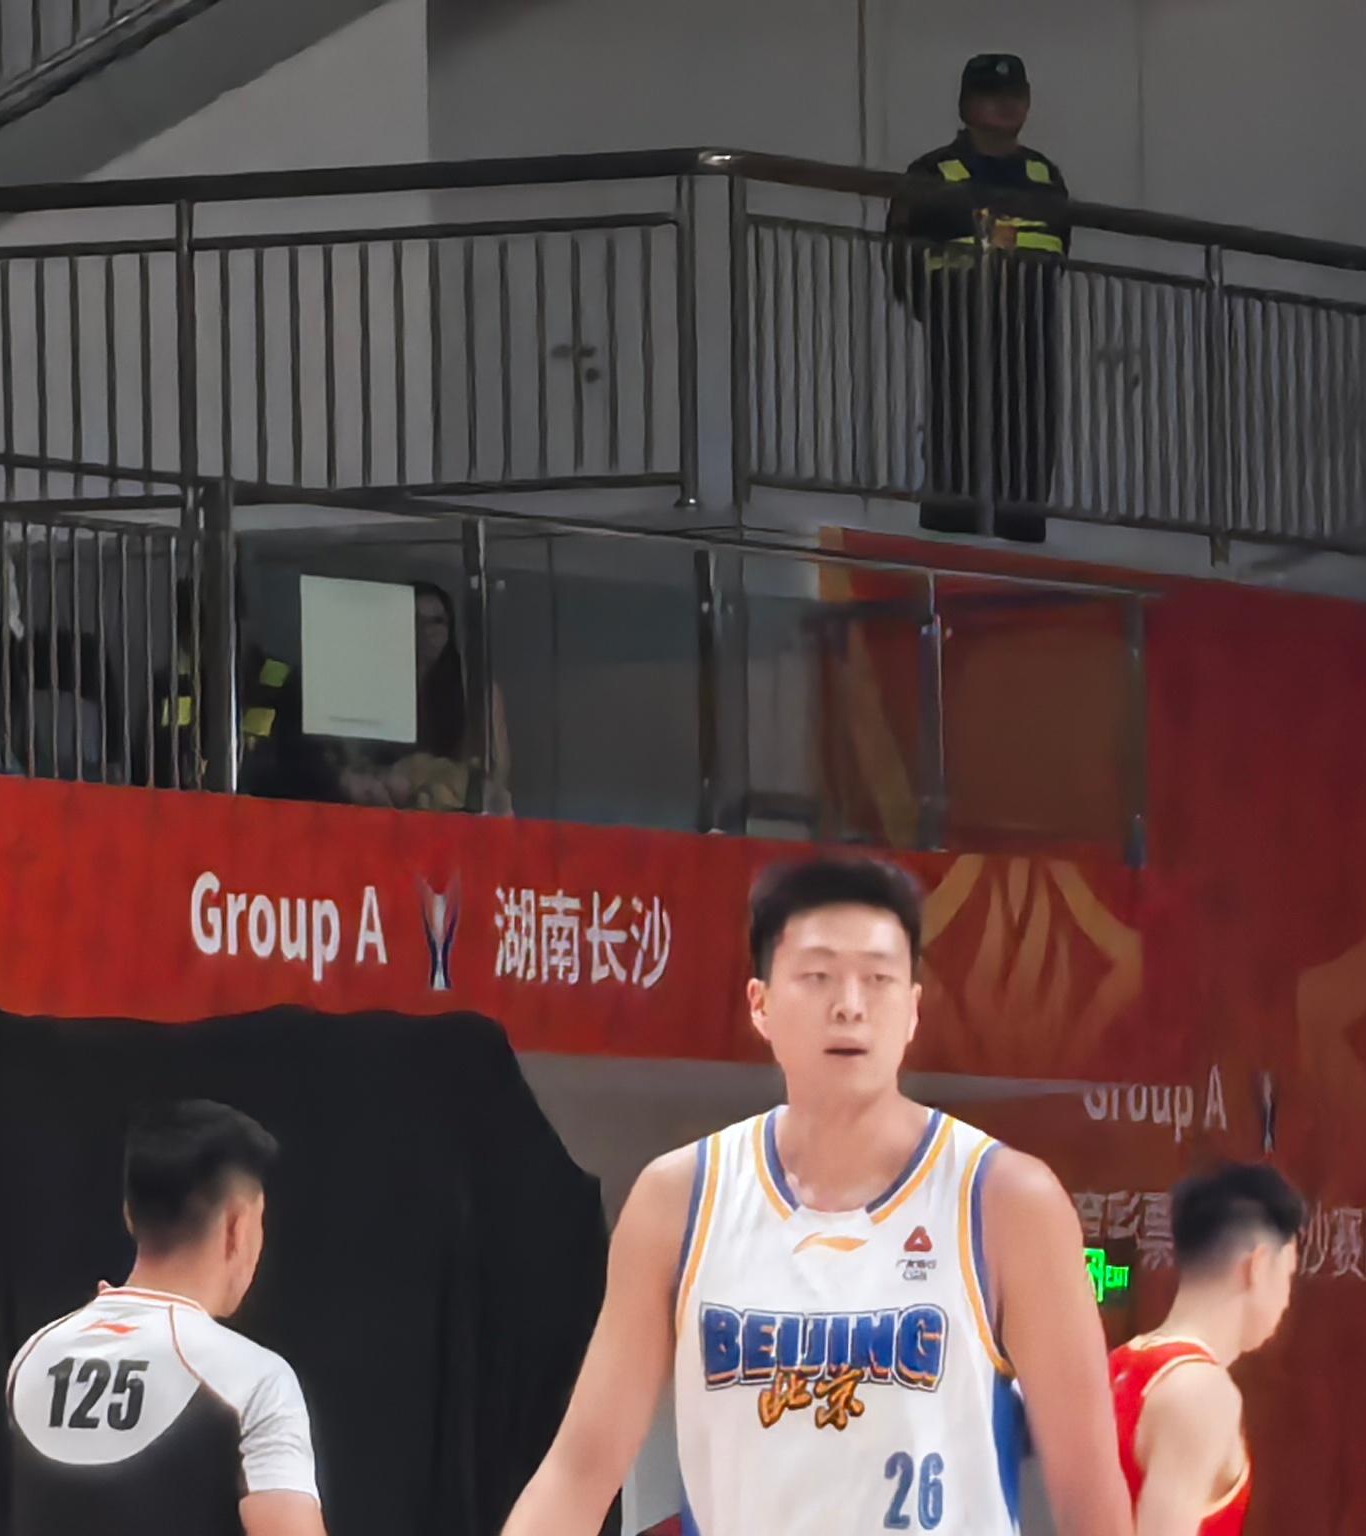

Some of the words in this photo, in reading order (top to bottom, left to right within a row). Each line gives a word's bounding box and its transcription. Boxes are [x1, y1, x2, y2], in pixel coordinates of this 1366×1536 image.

[191, 871, 341, 982] Group
[355, 886, 388, 964] A
[494, 887, 672, 989] 湖南长沙
[1203, 1064, 1227, 1131] A
[700, 1301, 947, 1392] BEIJING
[47, 1357, 149, 1431] 125
[757, 1367, 865, 1431] 北京
[883, 1451, 945, 1531] 26
